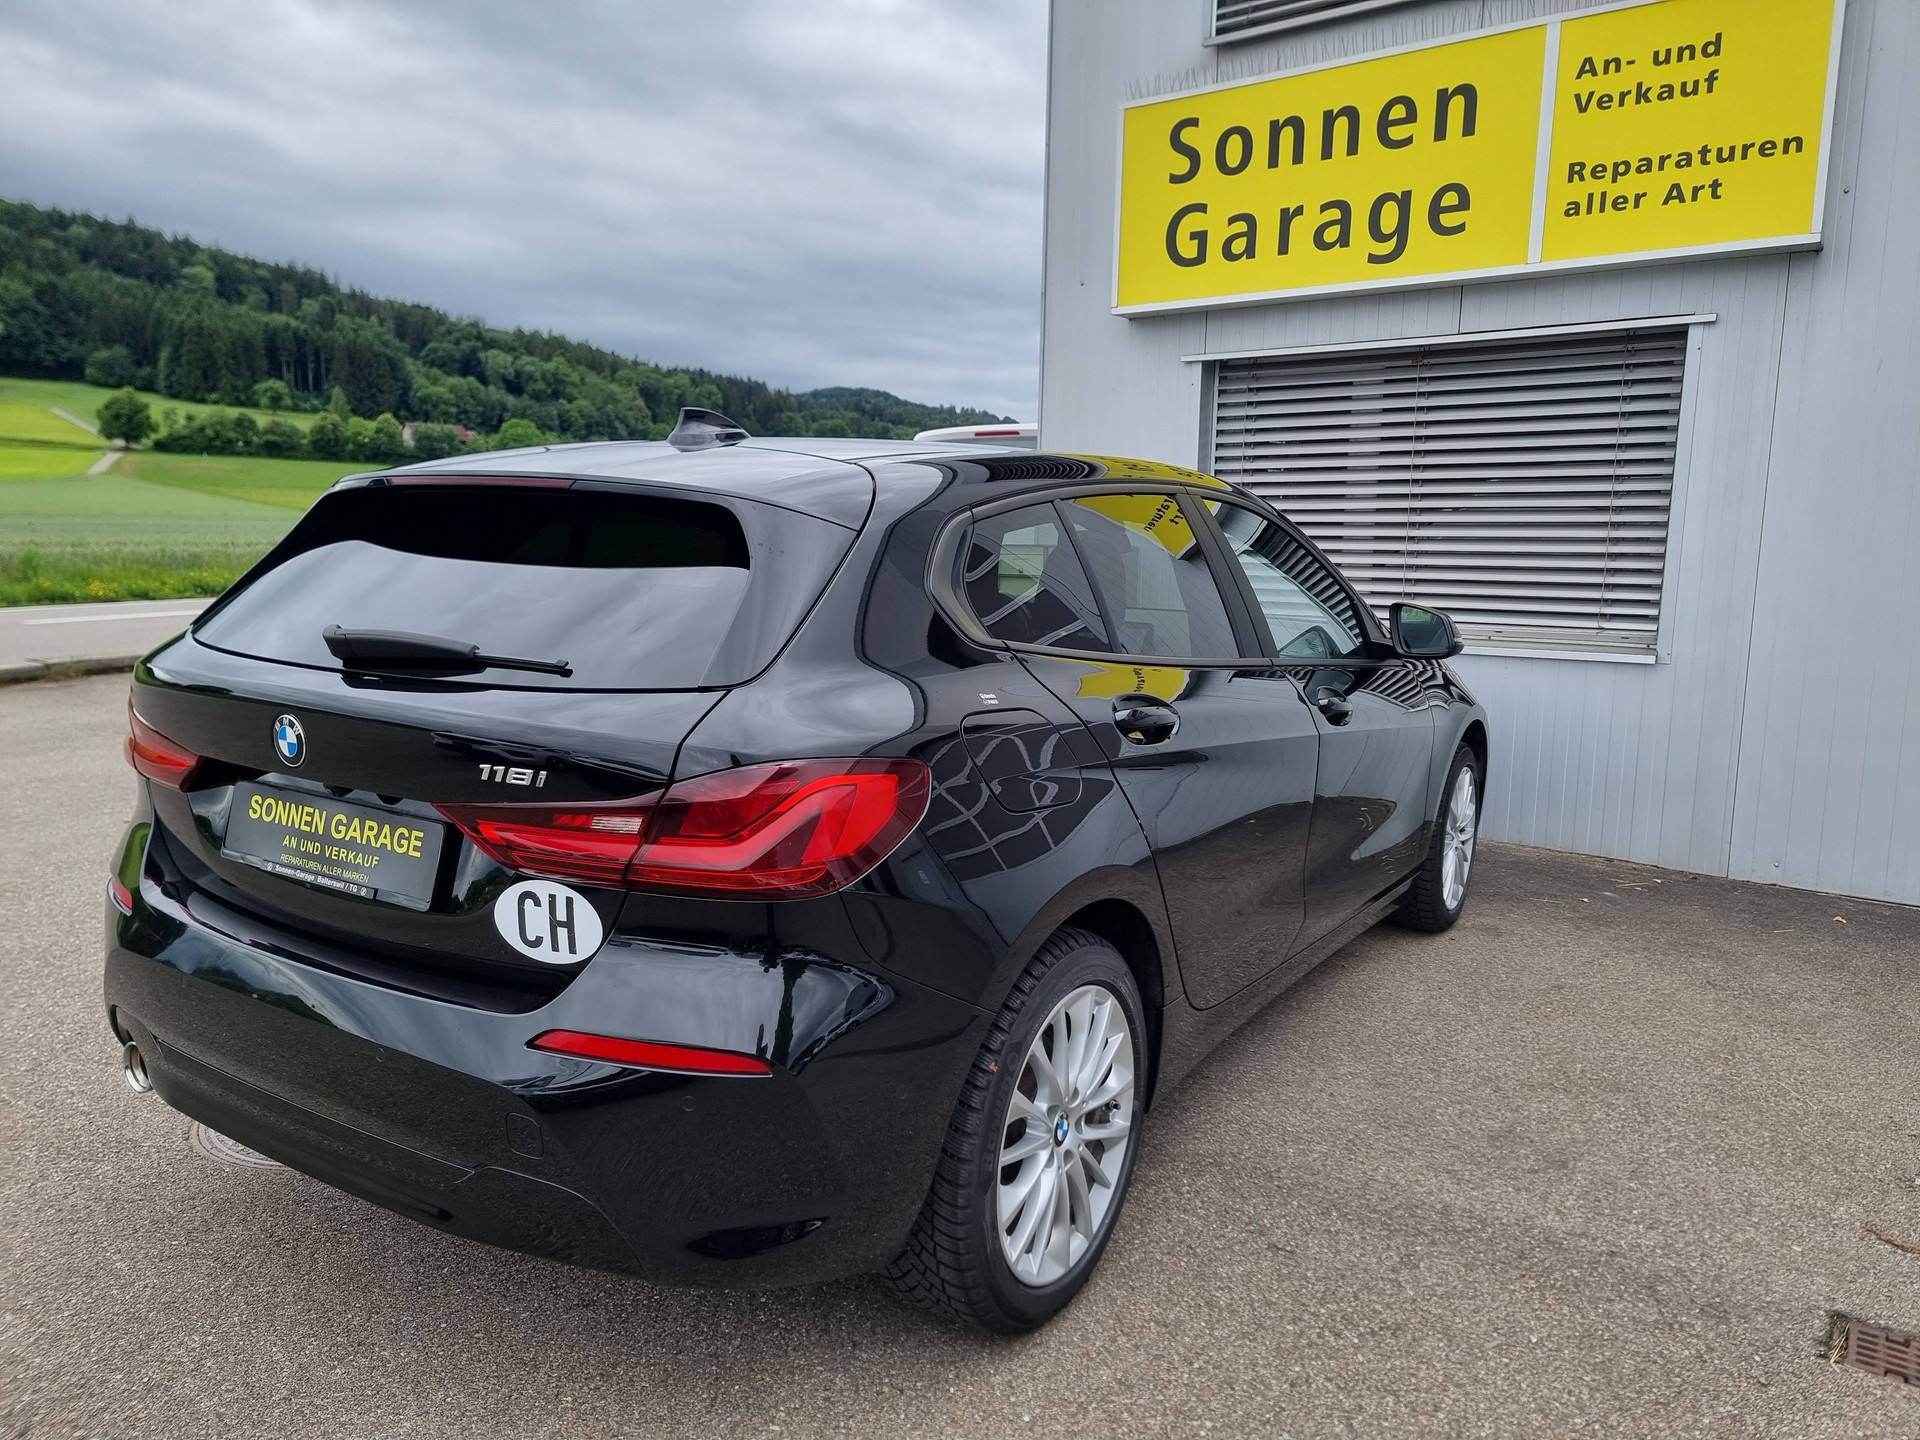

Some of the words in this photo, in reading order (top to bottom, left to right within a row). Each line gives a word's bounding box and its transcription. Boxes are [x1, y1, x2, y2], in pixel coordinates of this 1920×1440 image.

[1575, 56, 1636, 80] An-
[1652, 32, 1723, 67] und
[1573, 68, 1720, 114] Verkauf
[1168, 83, 1479, 185] Sonnen
[1566, 135, 1804, 185] Reparaturen
[1562, 190, 1648, 218] aller
[1661, 177, 1724, 206] Art
[1165, 182, 1471, 268] Garage
[479, 763, 548, 788] 118i
[248, 794, 328, 836] SONNEN
[330, 813, 425, 858] GARAGE
[279, 853, 322, 872] REPARATUREN
[322, 864, 342, 876] ALLER
[342, 869, 370, 884] MARKEN
[282, 835, 298, 850] AN
[300, 839, 322, 856] UND
[325, 845, 380, 869] VERKAUF
[275, 864, 315, 882] Sonnen-Garage
[349, 884, 358, 892] TG
[516, 890, 578, 955] CH
